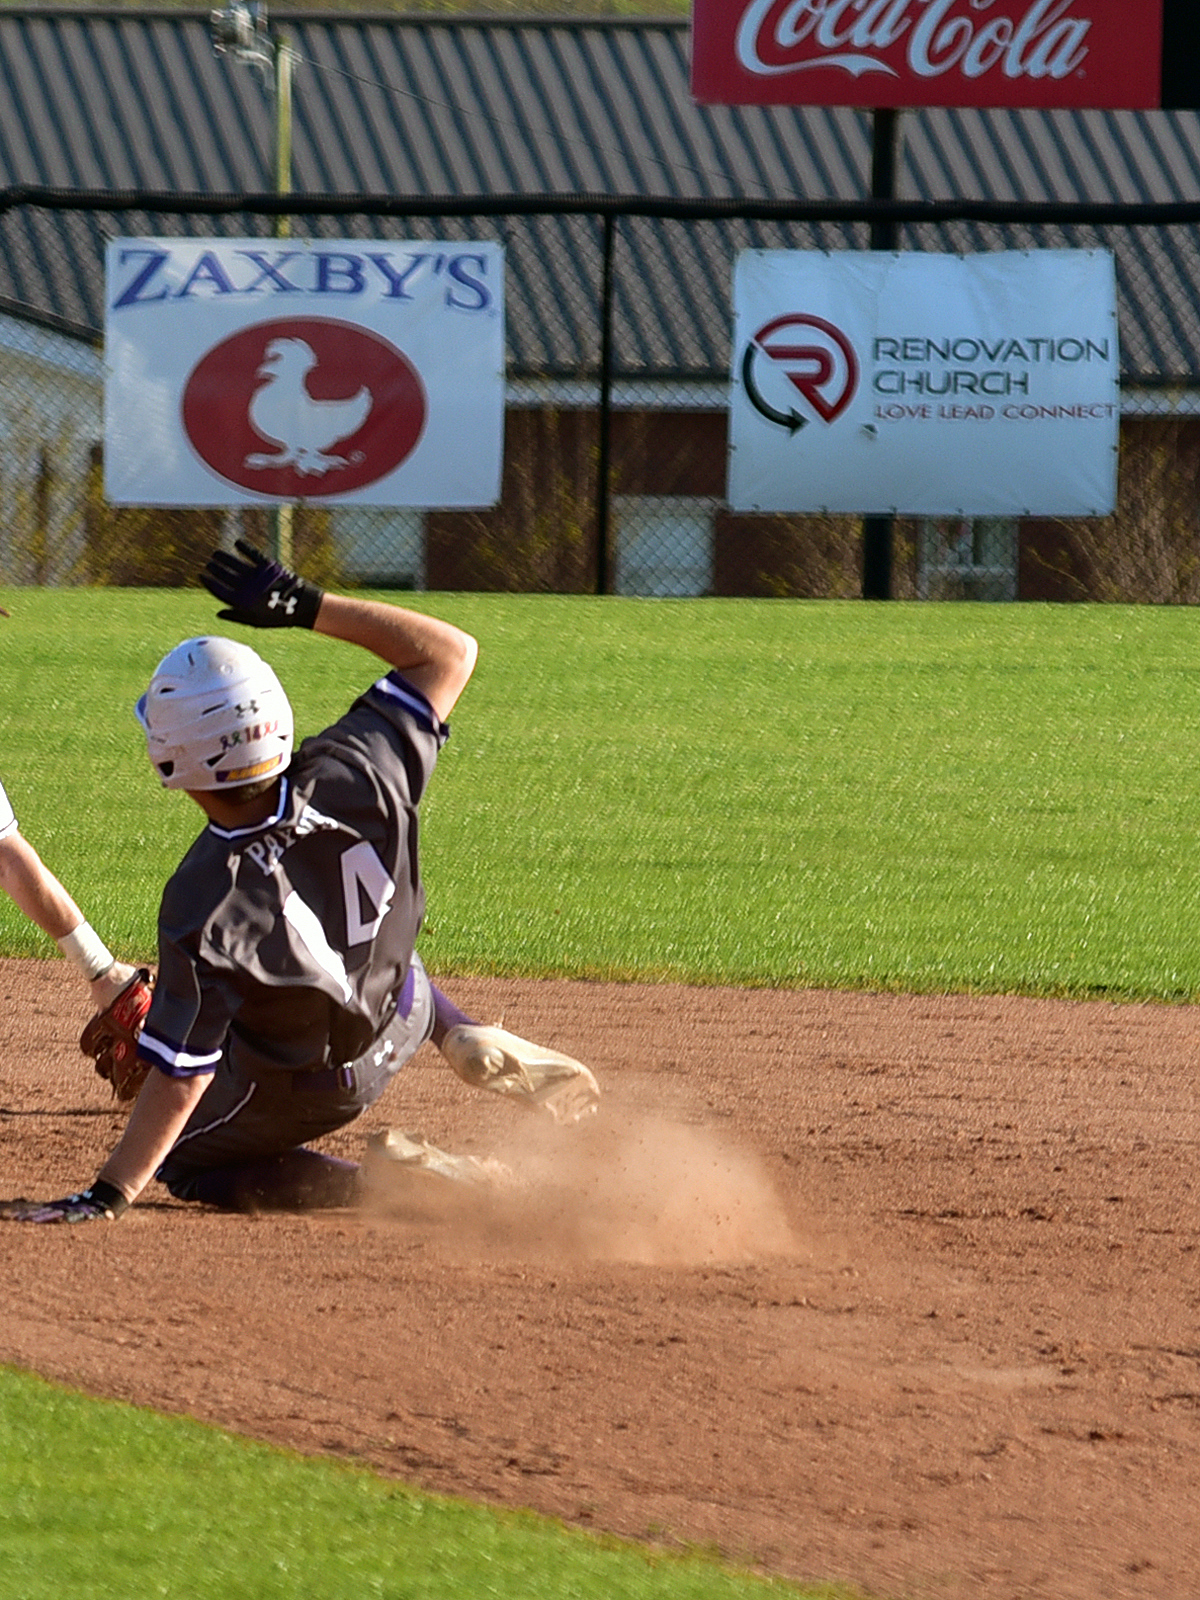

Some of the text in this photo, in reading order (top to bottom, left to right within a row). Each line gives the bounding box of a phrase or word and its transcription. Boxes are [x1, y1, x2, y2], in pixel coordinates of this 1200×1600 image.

[112, 248, 494, 311] ZAXBY'S
[873, 337, 1109, 363] RENOVATION
[873, 370, 1029, 396] CHURCH
[874, 403, 1117, 420] LOVE LEAD CONNECT
[340, 839, 396, 948] 4
